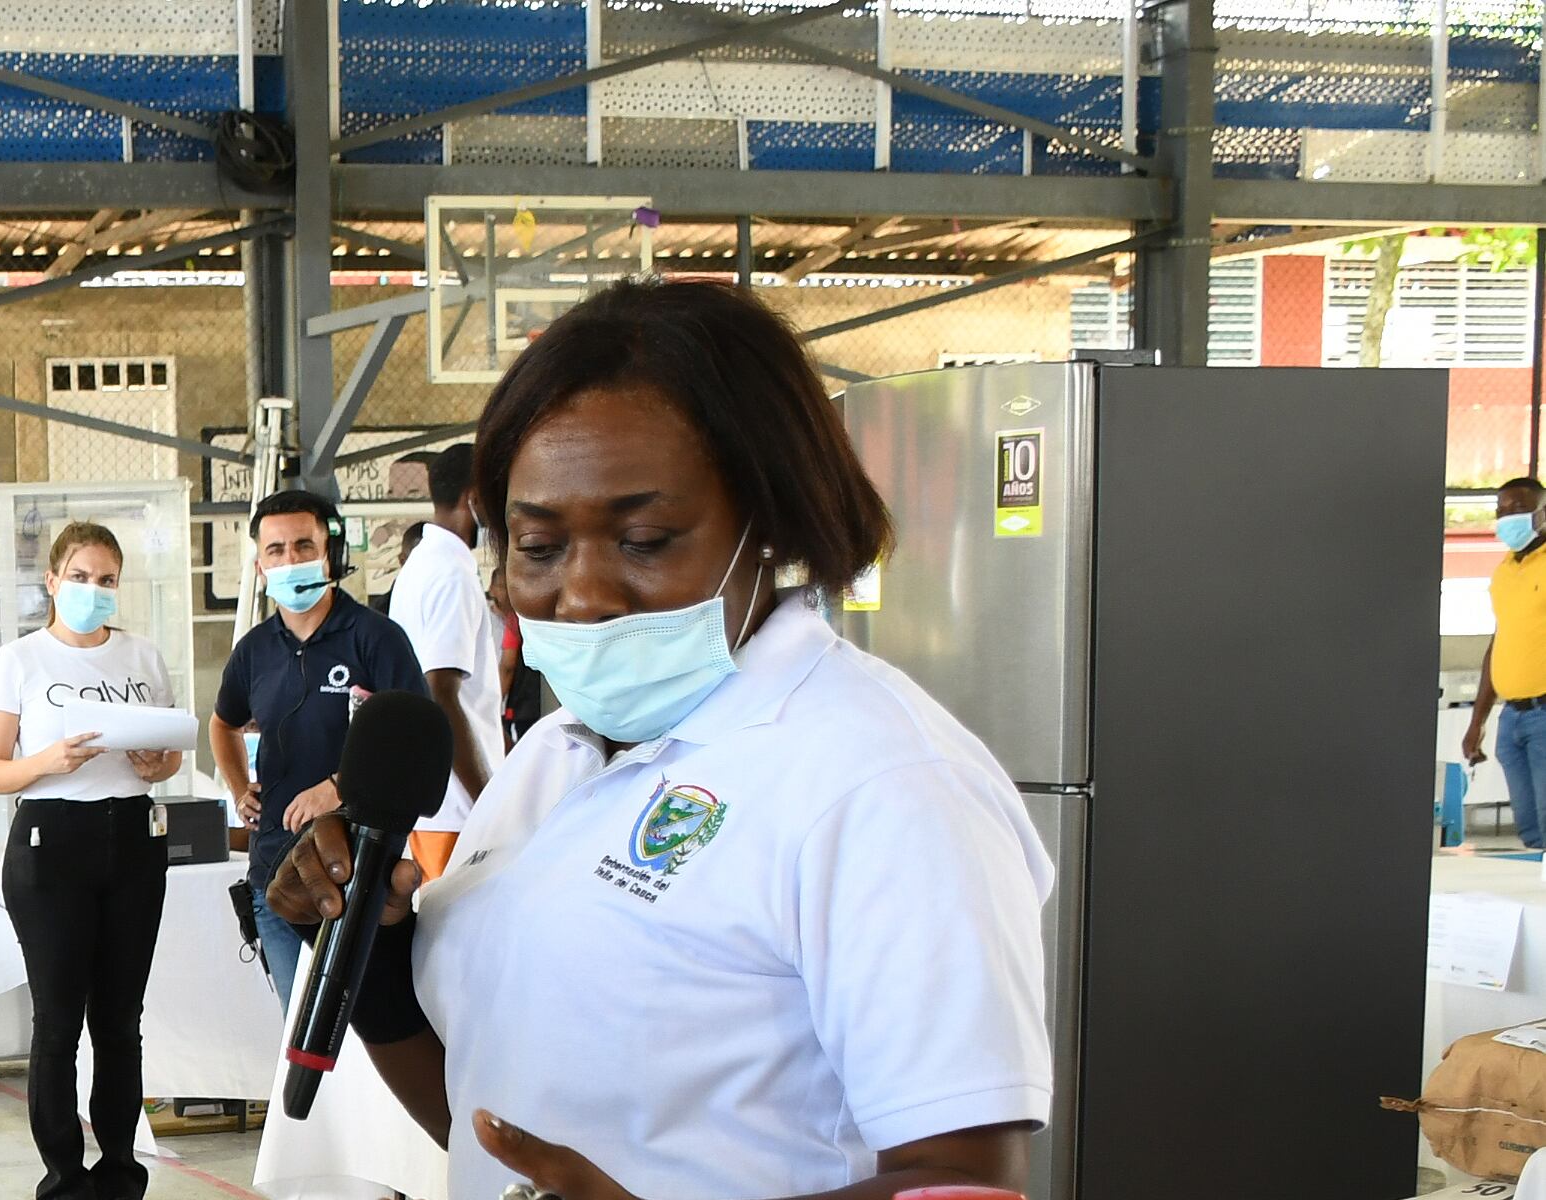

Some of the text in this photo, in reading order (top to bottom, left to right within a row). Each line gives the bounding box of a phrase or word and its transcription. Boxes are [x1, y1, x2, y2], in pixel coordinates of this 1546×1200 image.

[1002, 440, 1036, 481] 10
[1003, 480, 1034, 497] AÑOS
[1462, 1183, 1507, 1196] 50
